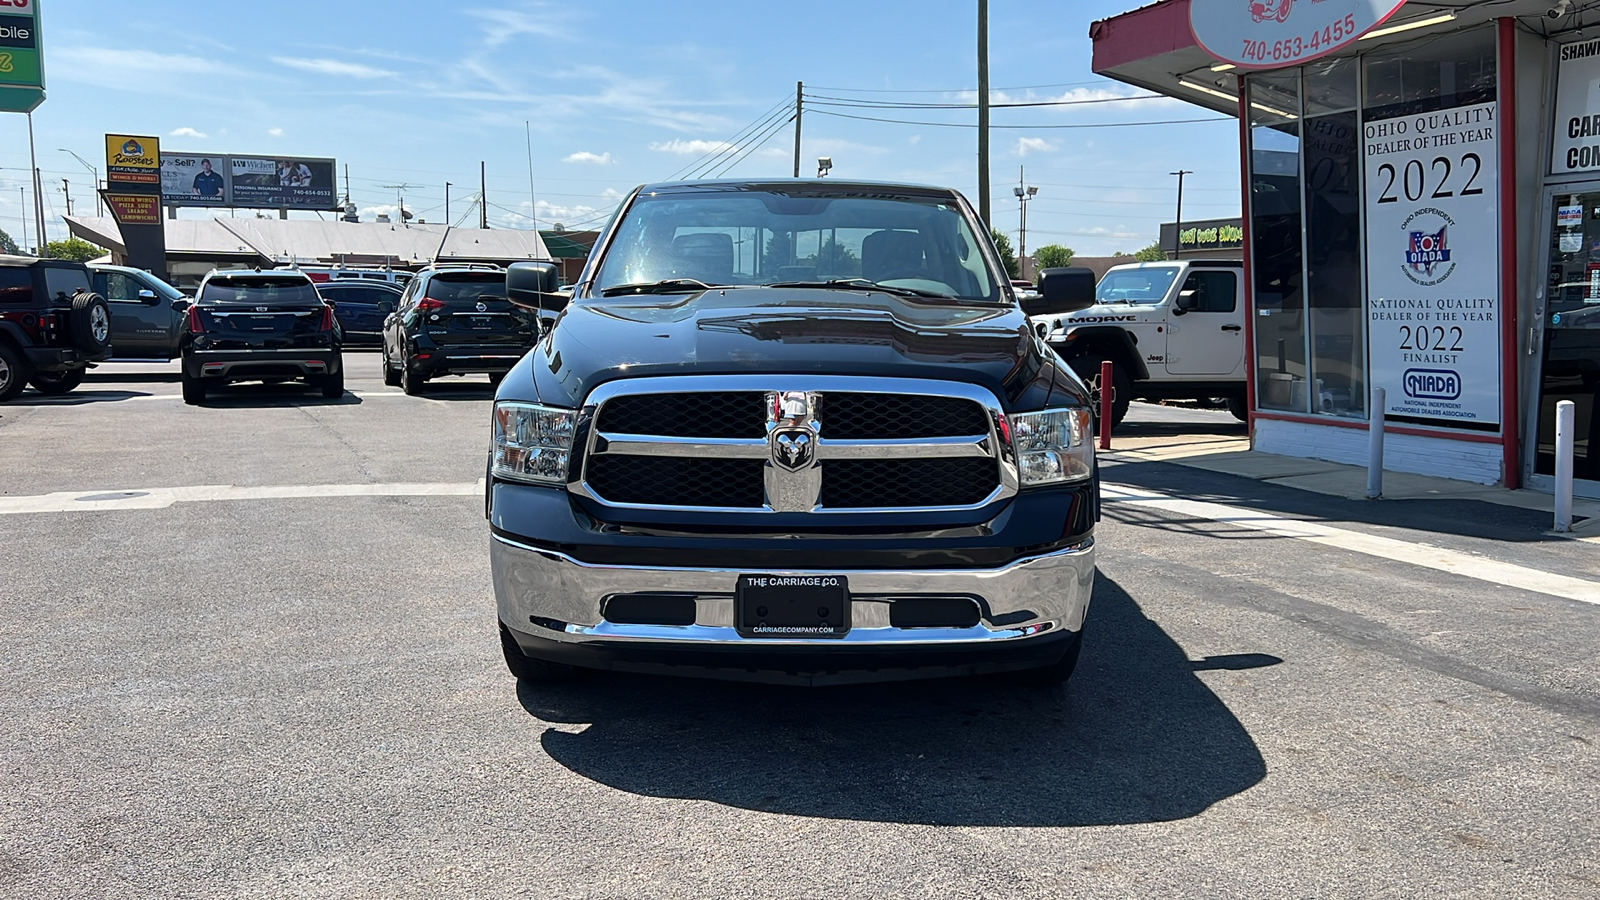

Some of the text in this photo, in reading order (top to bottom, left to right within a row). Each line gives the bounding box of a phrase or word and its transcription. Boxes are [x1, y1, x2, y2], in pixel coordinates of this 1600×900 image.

[1241, 12, 1355, 61] 740-653-4455
[1366, 106, 1495, 139] OHIO QUALITY
[1367, 127, 1493, 156] DEALER OF THE YEAR
[112, 153, 154, 165] Roosters
[174, 159, 196, 167] Sell?
[246, 160, 275, 169] Wichert
[1377, 152, 1483, 204] 2022
[1401, 207, 1456, 230] OHIO INDEPENDENT
[1411, 251, 1443, 262] OIADA
[1401, 264, 1420, 285] AUTOMOBILE
[1436, 262, 1457, 284] ASSOCIATION
[1370, 299, 1494, 310] NATIONAL QUALITY
[1067, 315, 1137, 324] MOJAVE
[1372, 312, 1493, 321] DEALER OF THE YEAR
[1399, 325, 1464, 352] 2022
[1147, 354, 1164, 362] Jeep
[1403, 353, 1458, 363] FINALIST
[1407, 375, 1456, 394] NIADA
[1428, 401, 1461, 409] INDEPENDENT
[1391, 406, 1420, 414] AUTOMOBILE
[1442, 410, 1477, 418] ASSOCIATION
[747, 577, 840, 587] THE CARRIAGE CO.
